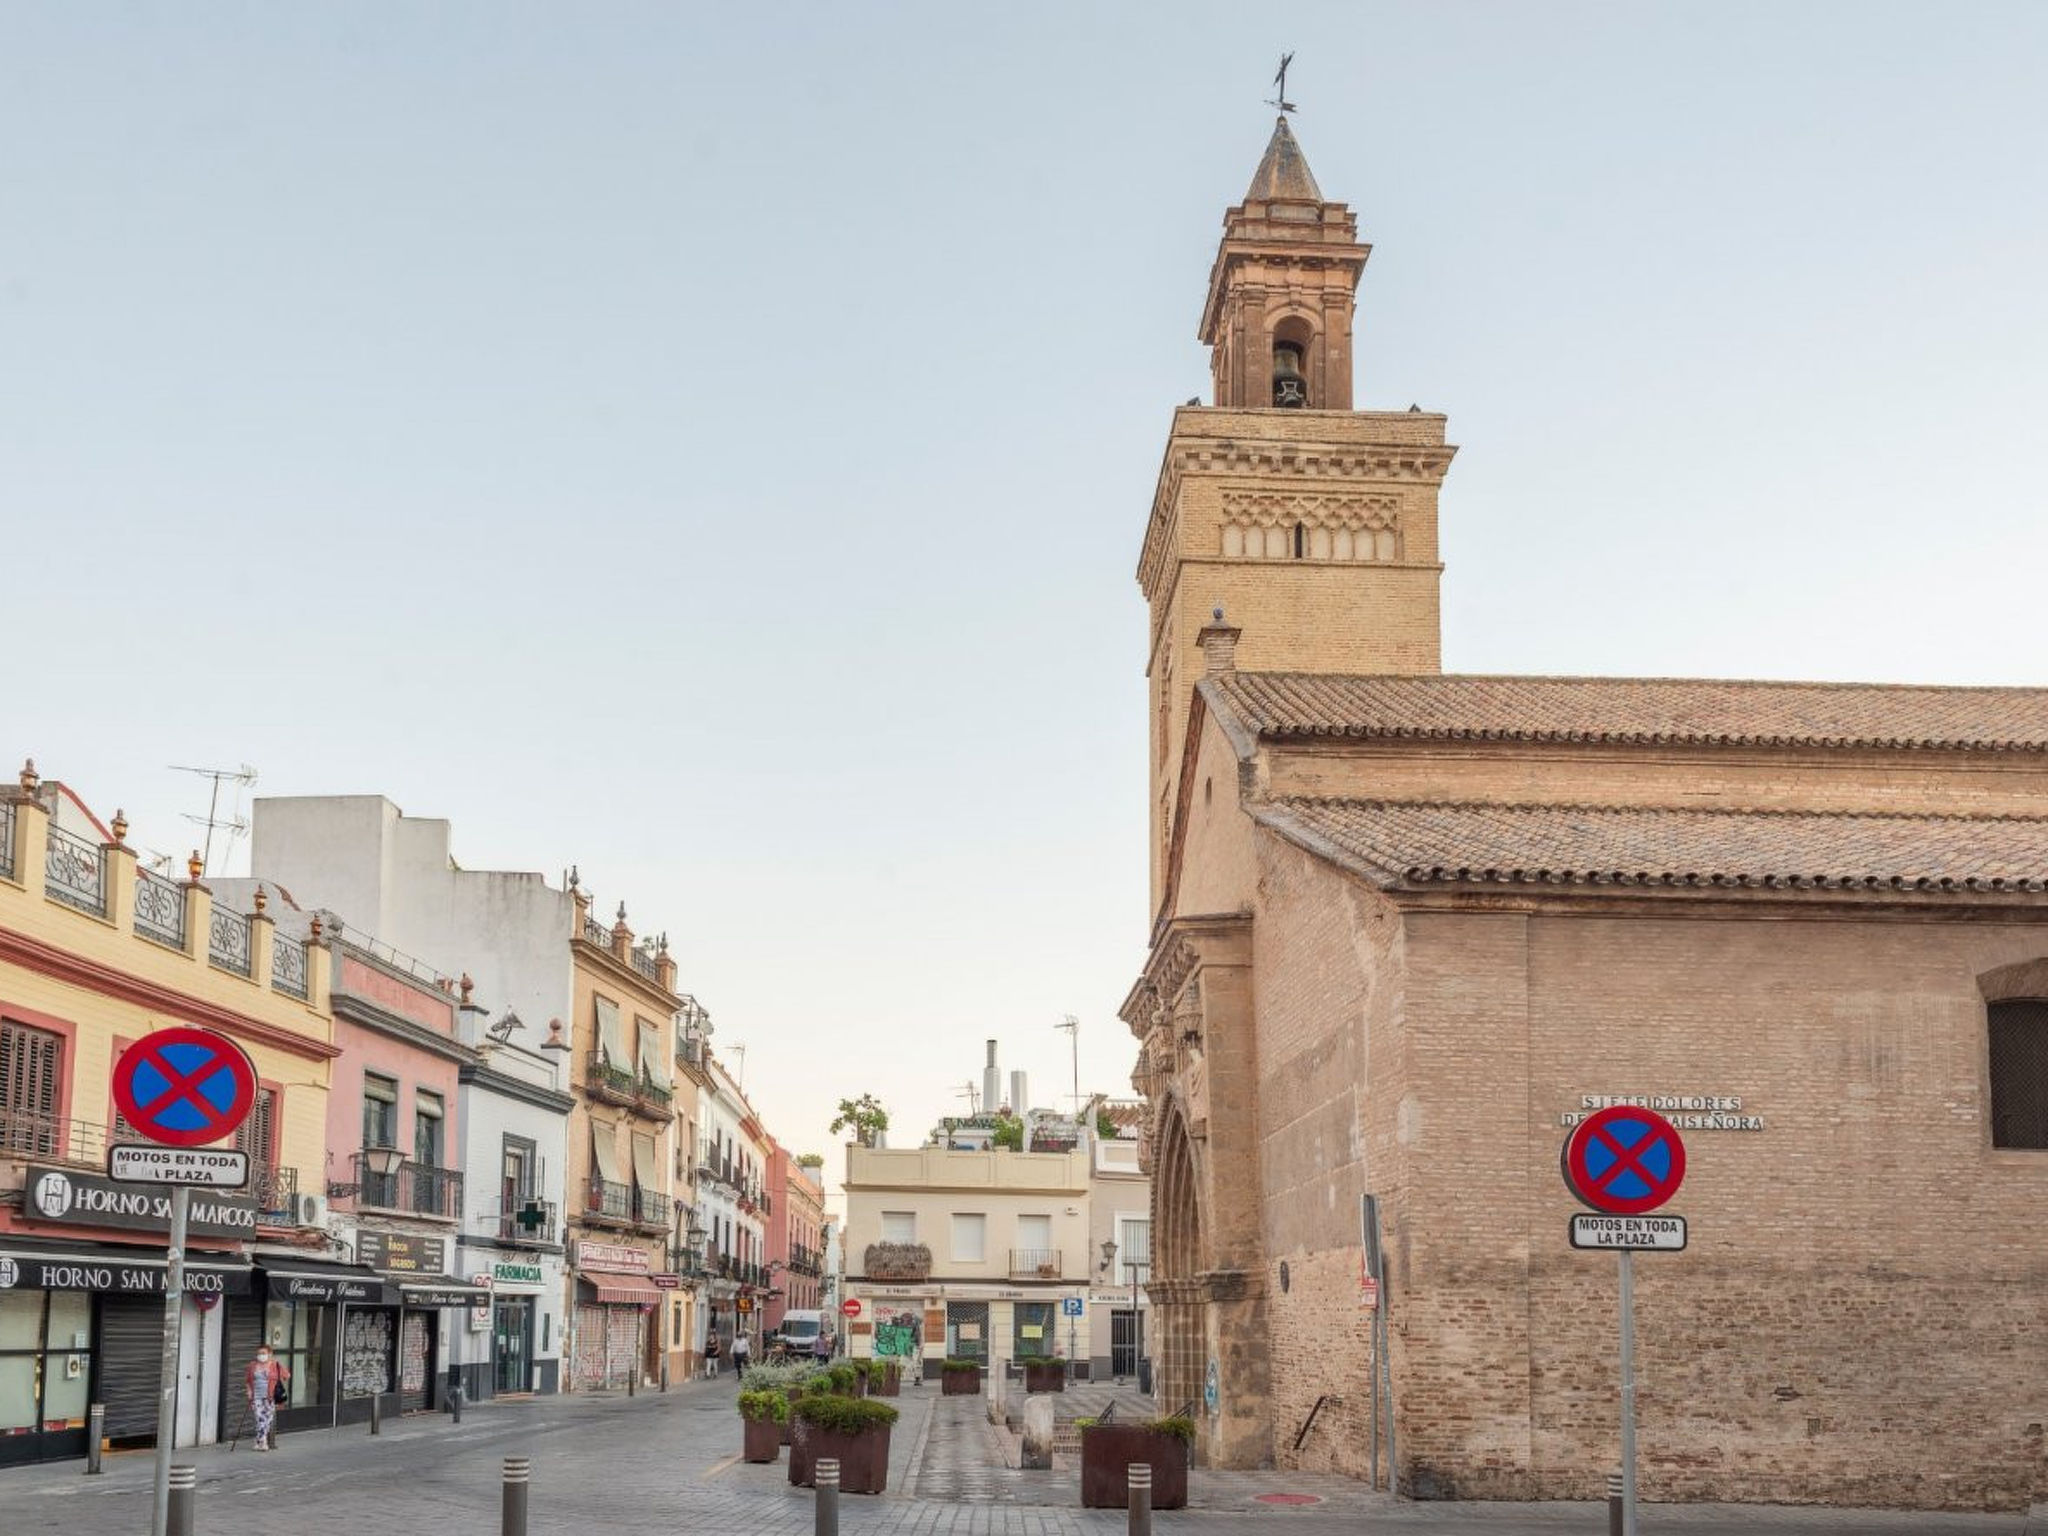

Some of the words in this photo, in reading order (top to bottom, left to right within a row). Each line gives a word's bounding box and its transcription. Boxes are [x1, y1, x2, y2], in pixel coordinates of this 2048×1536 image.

[1653, 1096, 1741, 1110] DOLORES
[1687, 1111, 1763, 1131] SEÑORA
[117, 1151, 170, 1164] MOTOS
[175, 1154, 195, 1165] EN
[200, 1156, 239, 1168] TODA
[165, 1169, 213, 1182] PLAZA
[75, 1188, 150, 1216] HORNO
[152, 1197, 174, 1219] SA
[190, 1201, 255, 1228] MARCOS
[1579, 1218, 1622, 1231] MOTOS
[1626, 1219, 1643, 1231] EN
[1646, 1220, 1678, 1233] TODA
[1598, 1232, 1613, 1244] LA
[1616, 1233, 1656, 1245] PLAZA
[41, 1265, 112, 1289] HORNO
[121, 1268, 154, 1290] SAN
[495, 1264, 542, 1281] FARMACIA
